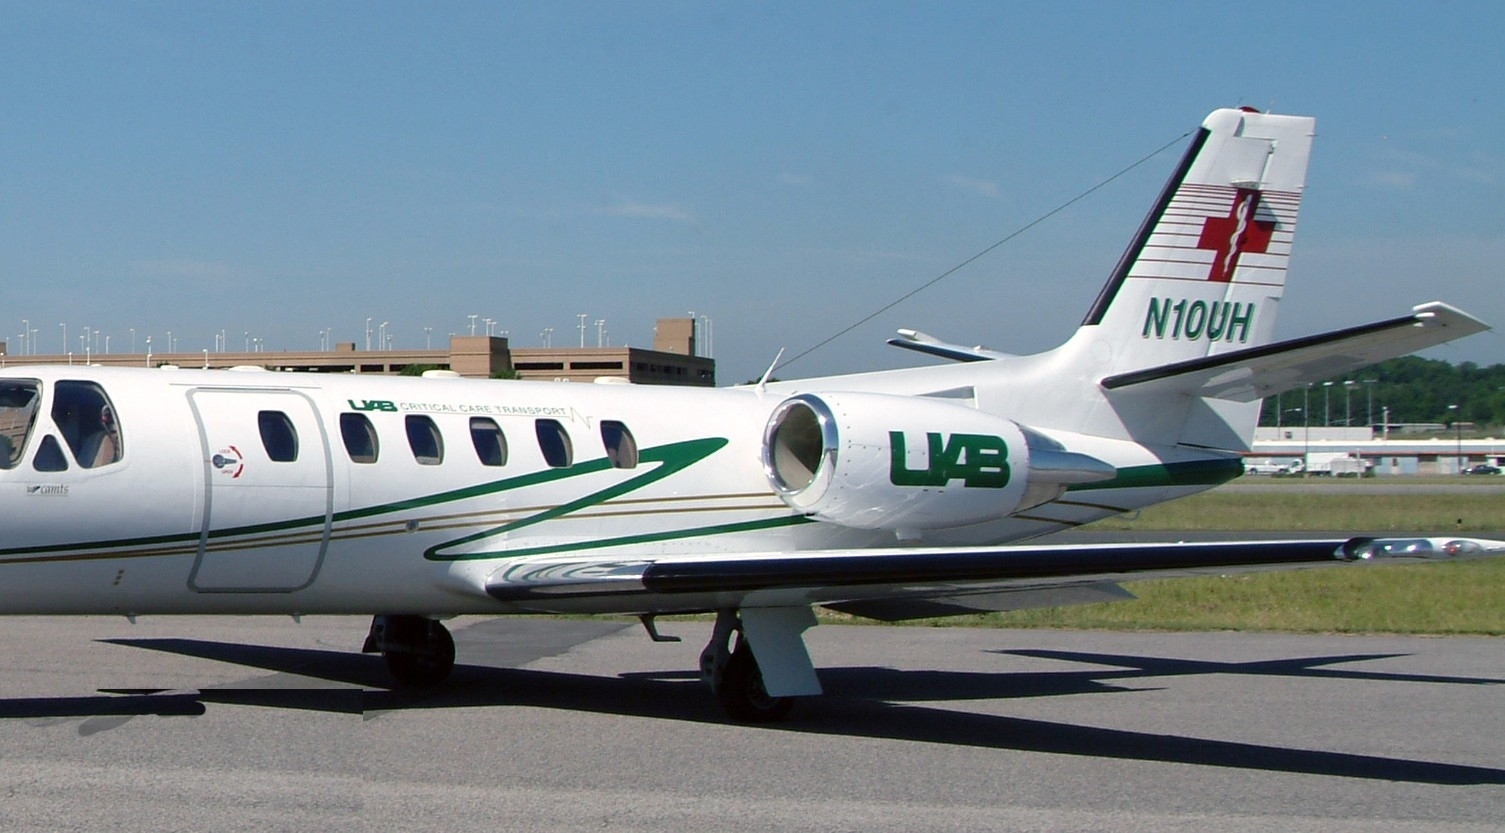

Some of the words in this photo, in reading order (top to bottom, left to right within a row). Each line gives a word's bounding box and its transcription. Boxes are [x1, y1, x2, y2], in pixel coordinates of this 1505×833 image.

[1142, 297, 1254, 343] N10UH
[347, 399, 399, 412] UAB
[400, 402, 456, 412] CRITICAL
[459, 405, 493, 413] CARE
[495, 405, 567, 415] TRANSPORT
[889, 431, 1011, 488] UAB
